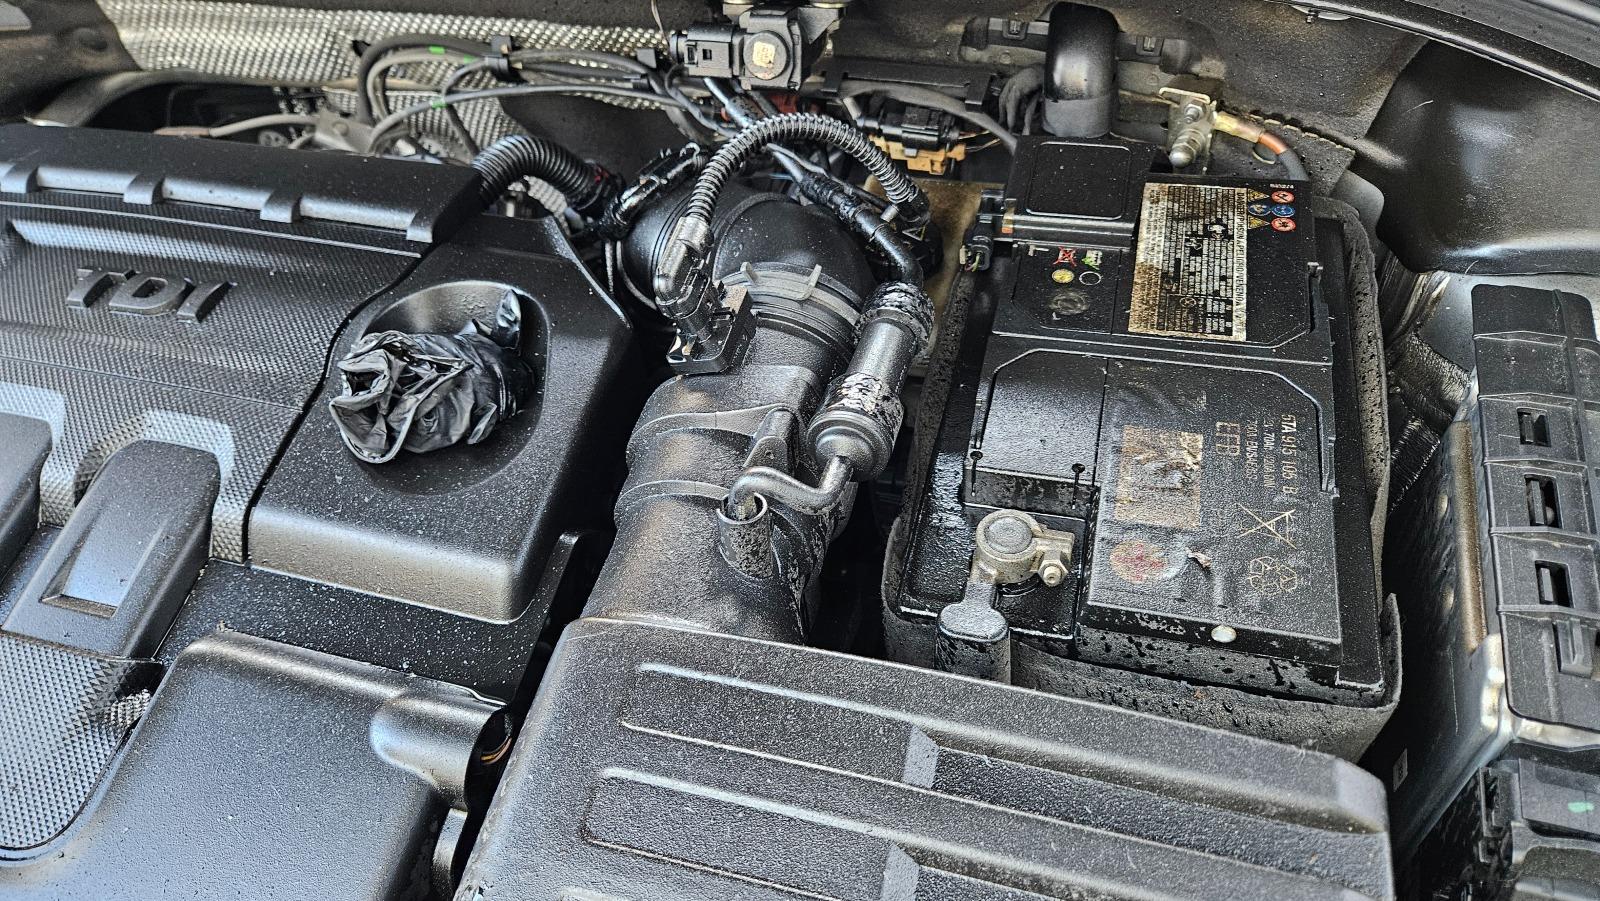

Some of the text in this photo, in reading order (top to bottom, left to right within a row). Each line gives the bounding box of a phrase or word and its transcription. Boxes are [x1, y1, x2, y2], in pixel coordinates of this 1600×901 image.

[66, 267, 236, 324] TDI
[1281, 414, 1297, 433] 5TA
[1216, 421, 1241, 456] EFB
[1281, 436, 1297, 456] 915
[1282, 485, 1299, 495] B
